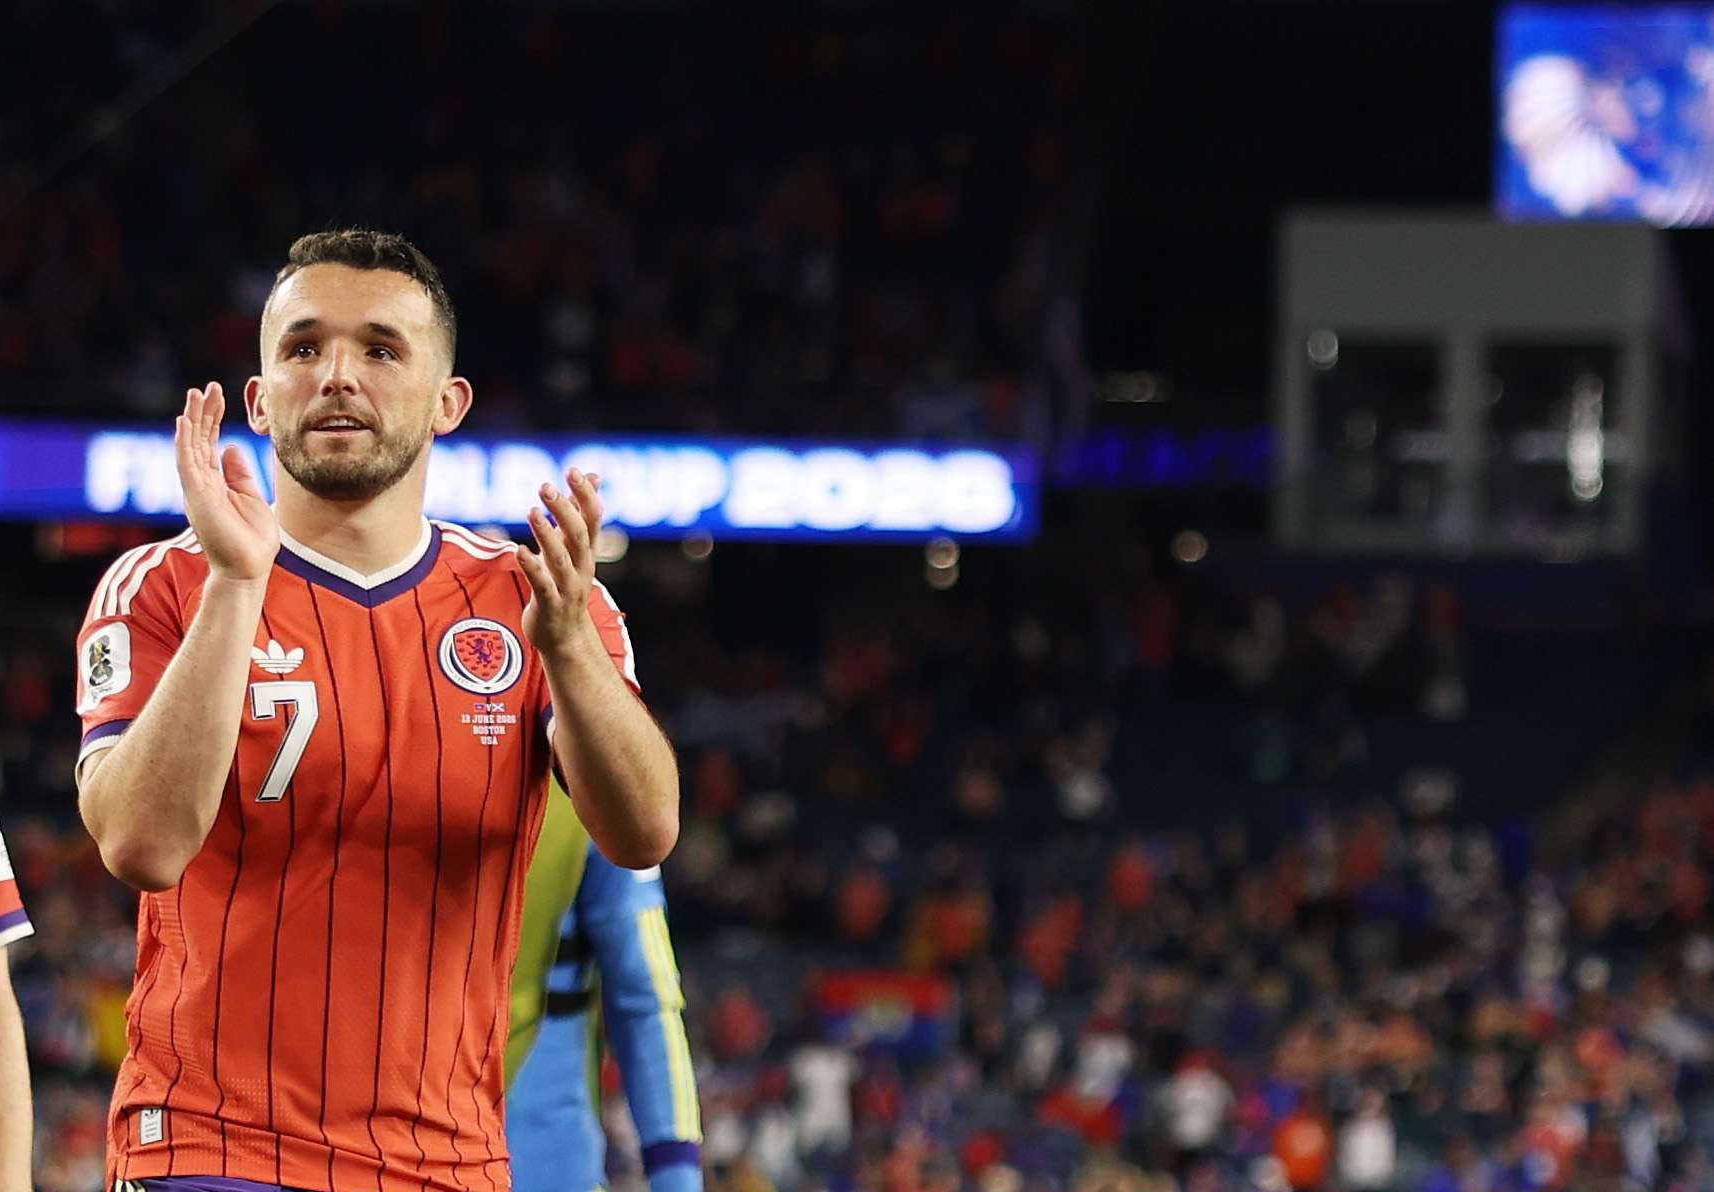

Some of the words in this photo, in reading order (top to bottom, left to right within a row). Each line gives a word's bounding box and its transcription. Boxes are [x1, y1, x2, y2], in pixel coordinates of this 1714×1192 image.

[562, 445, 728, 528] CUP
[730, 447, 1015, 533] 2026
[251, 681, 318, 802] 7
[480, 736, 499, 745] USA
